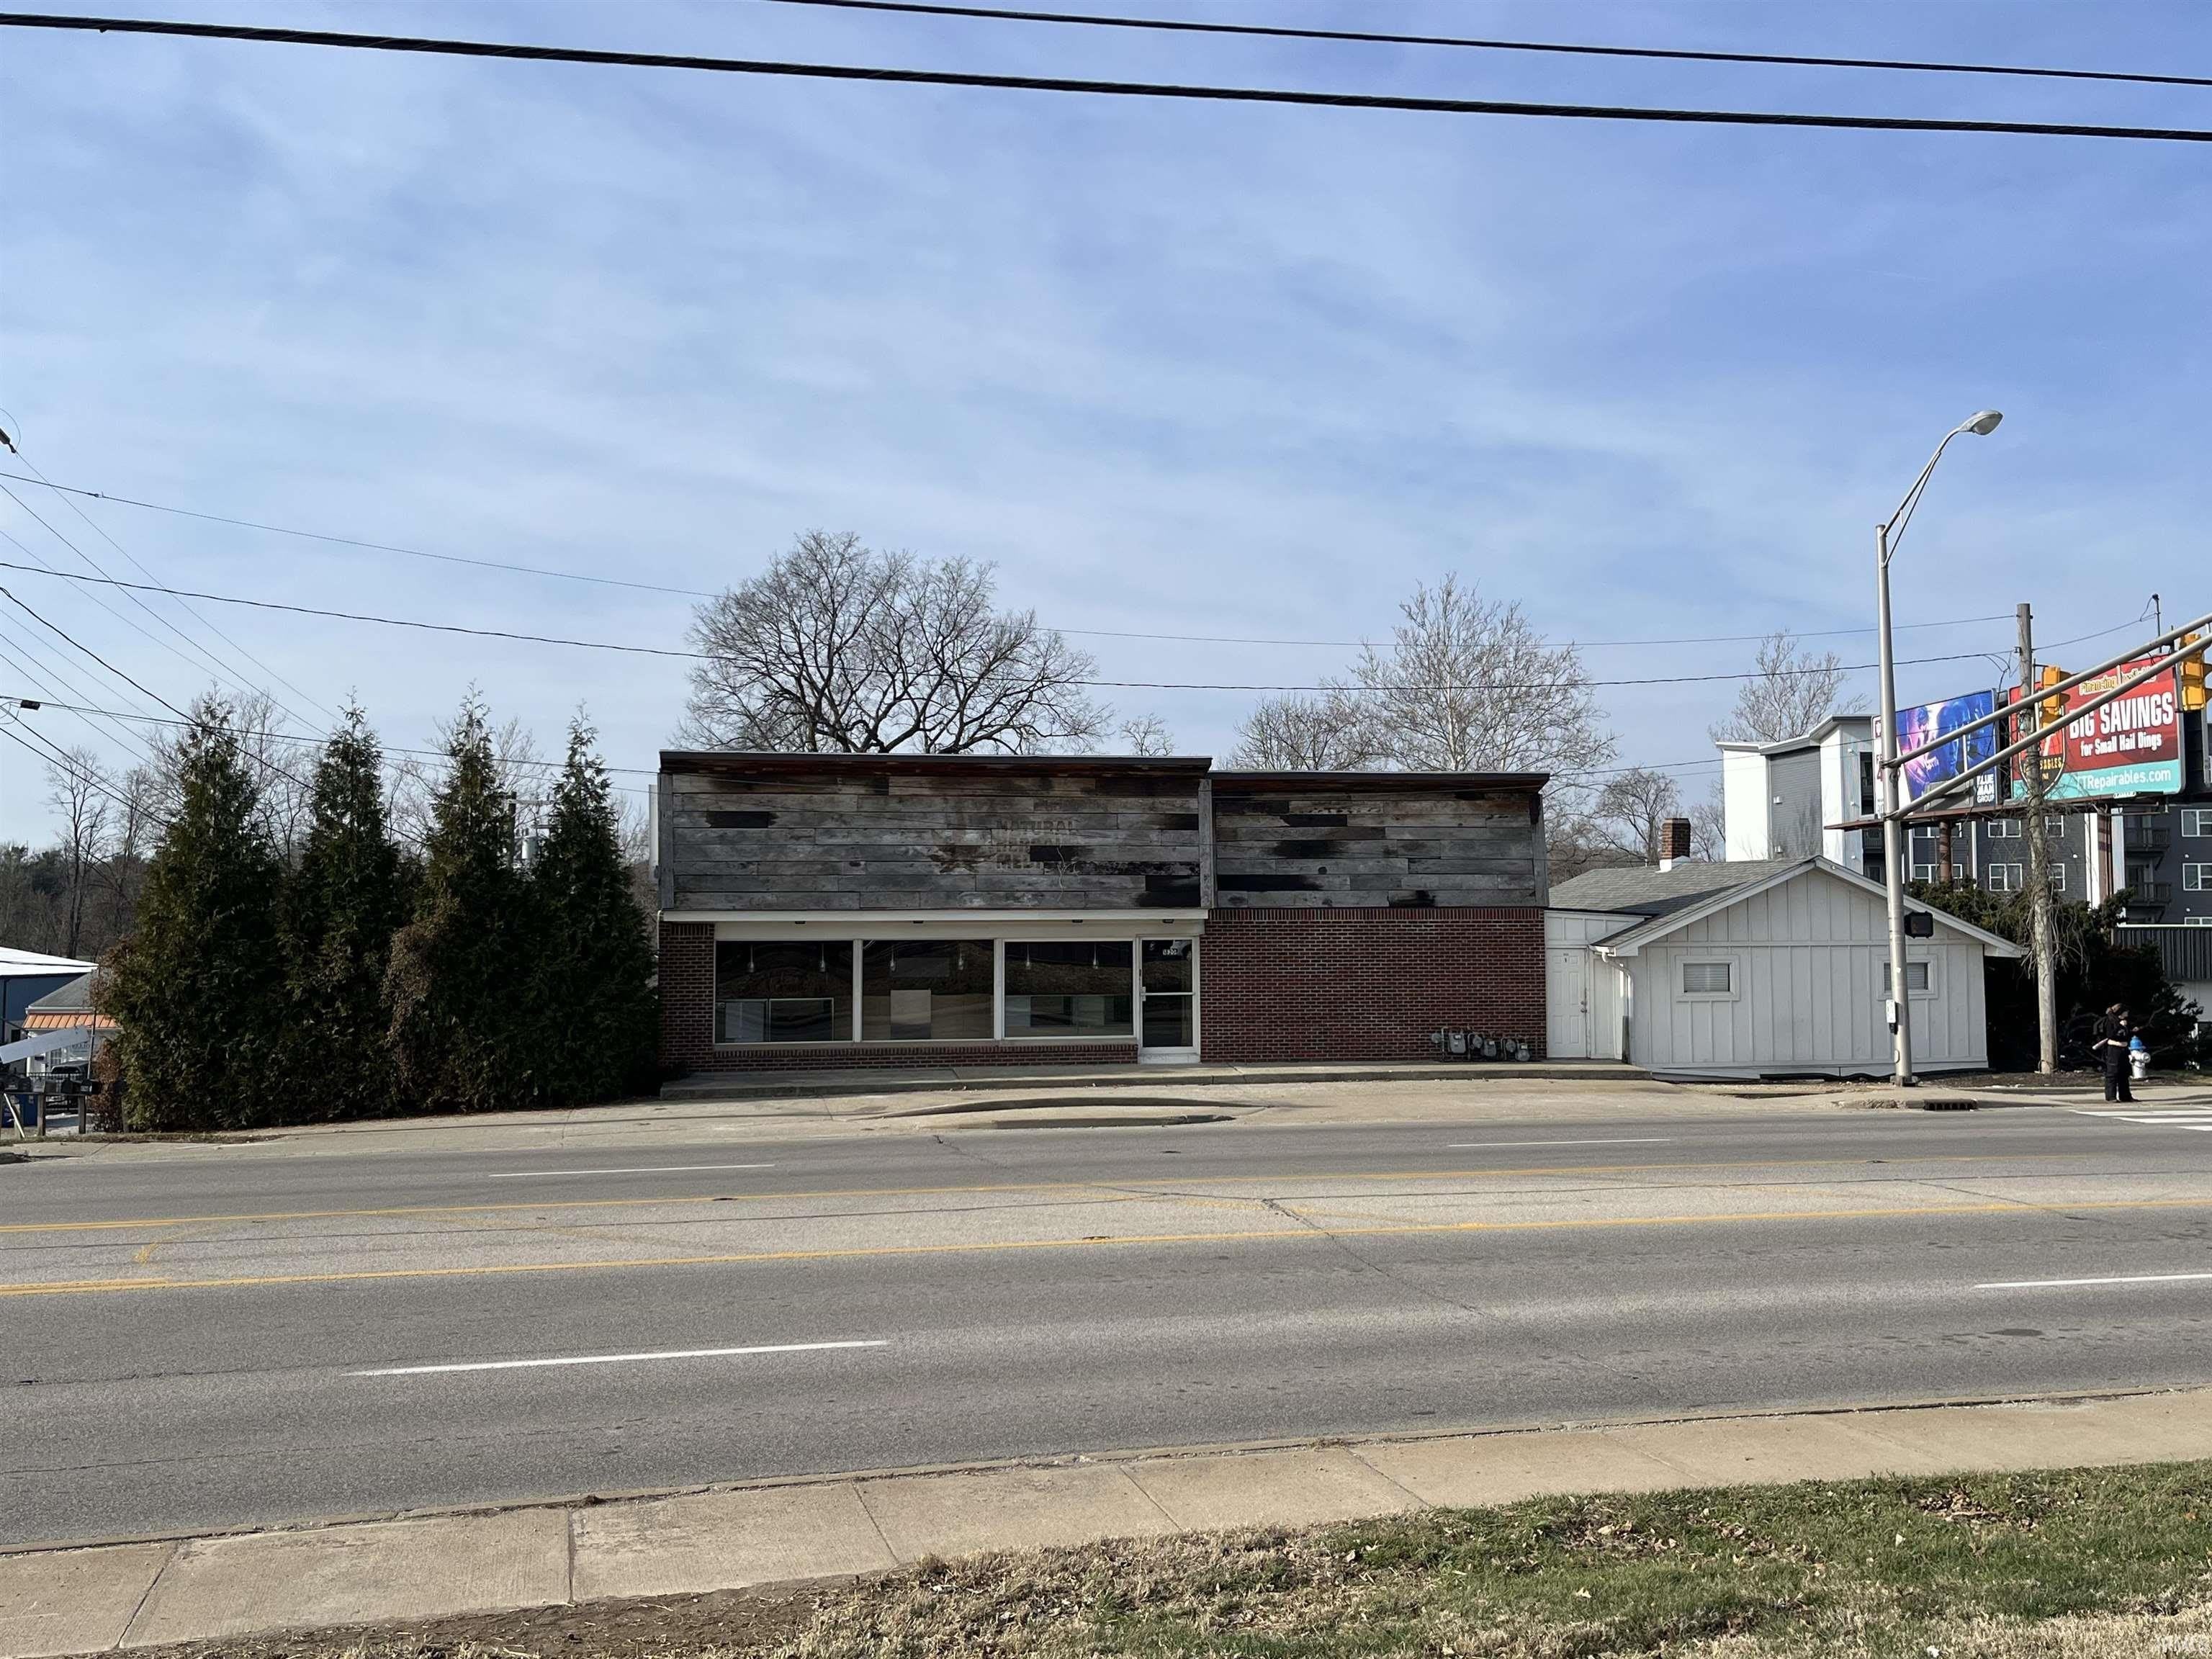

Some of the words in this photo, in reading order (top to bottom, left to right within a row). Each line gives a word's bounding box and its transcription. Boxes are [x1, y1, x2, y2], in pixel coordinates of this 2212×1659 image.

[2069, 709, 2095, 739] BIG
[2100, 692, 2174, 734] SAVINGS
[2080, 741, 2092, 757] for
[2095, 735, 2117, 755] Small
[2119, 732, 2136, 751] Hail
[2138, 731, 2162, 751] Dings
